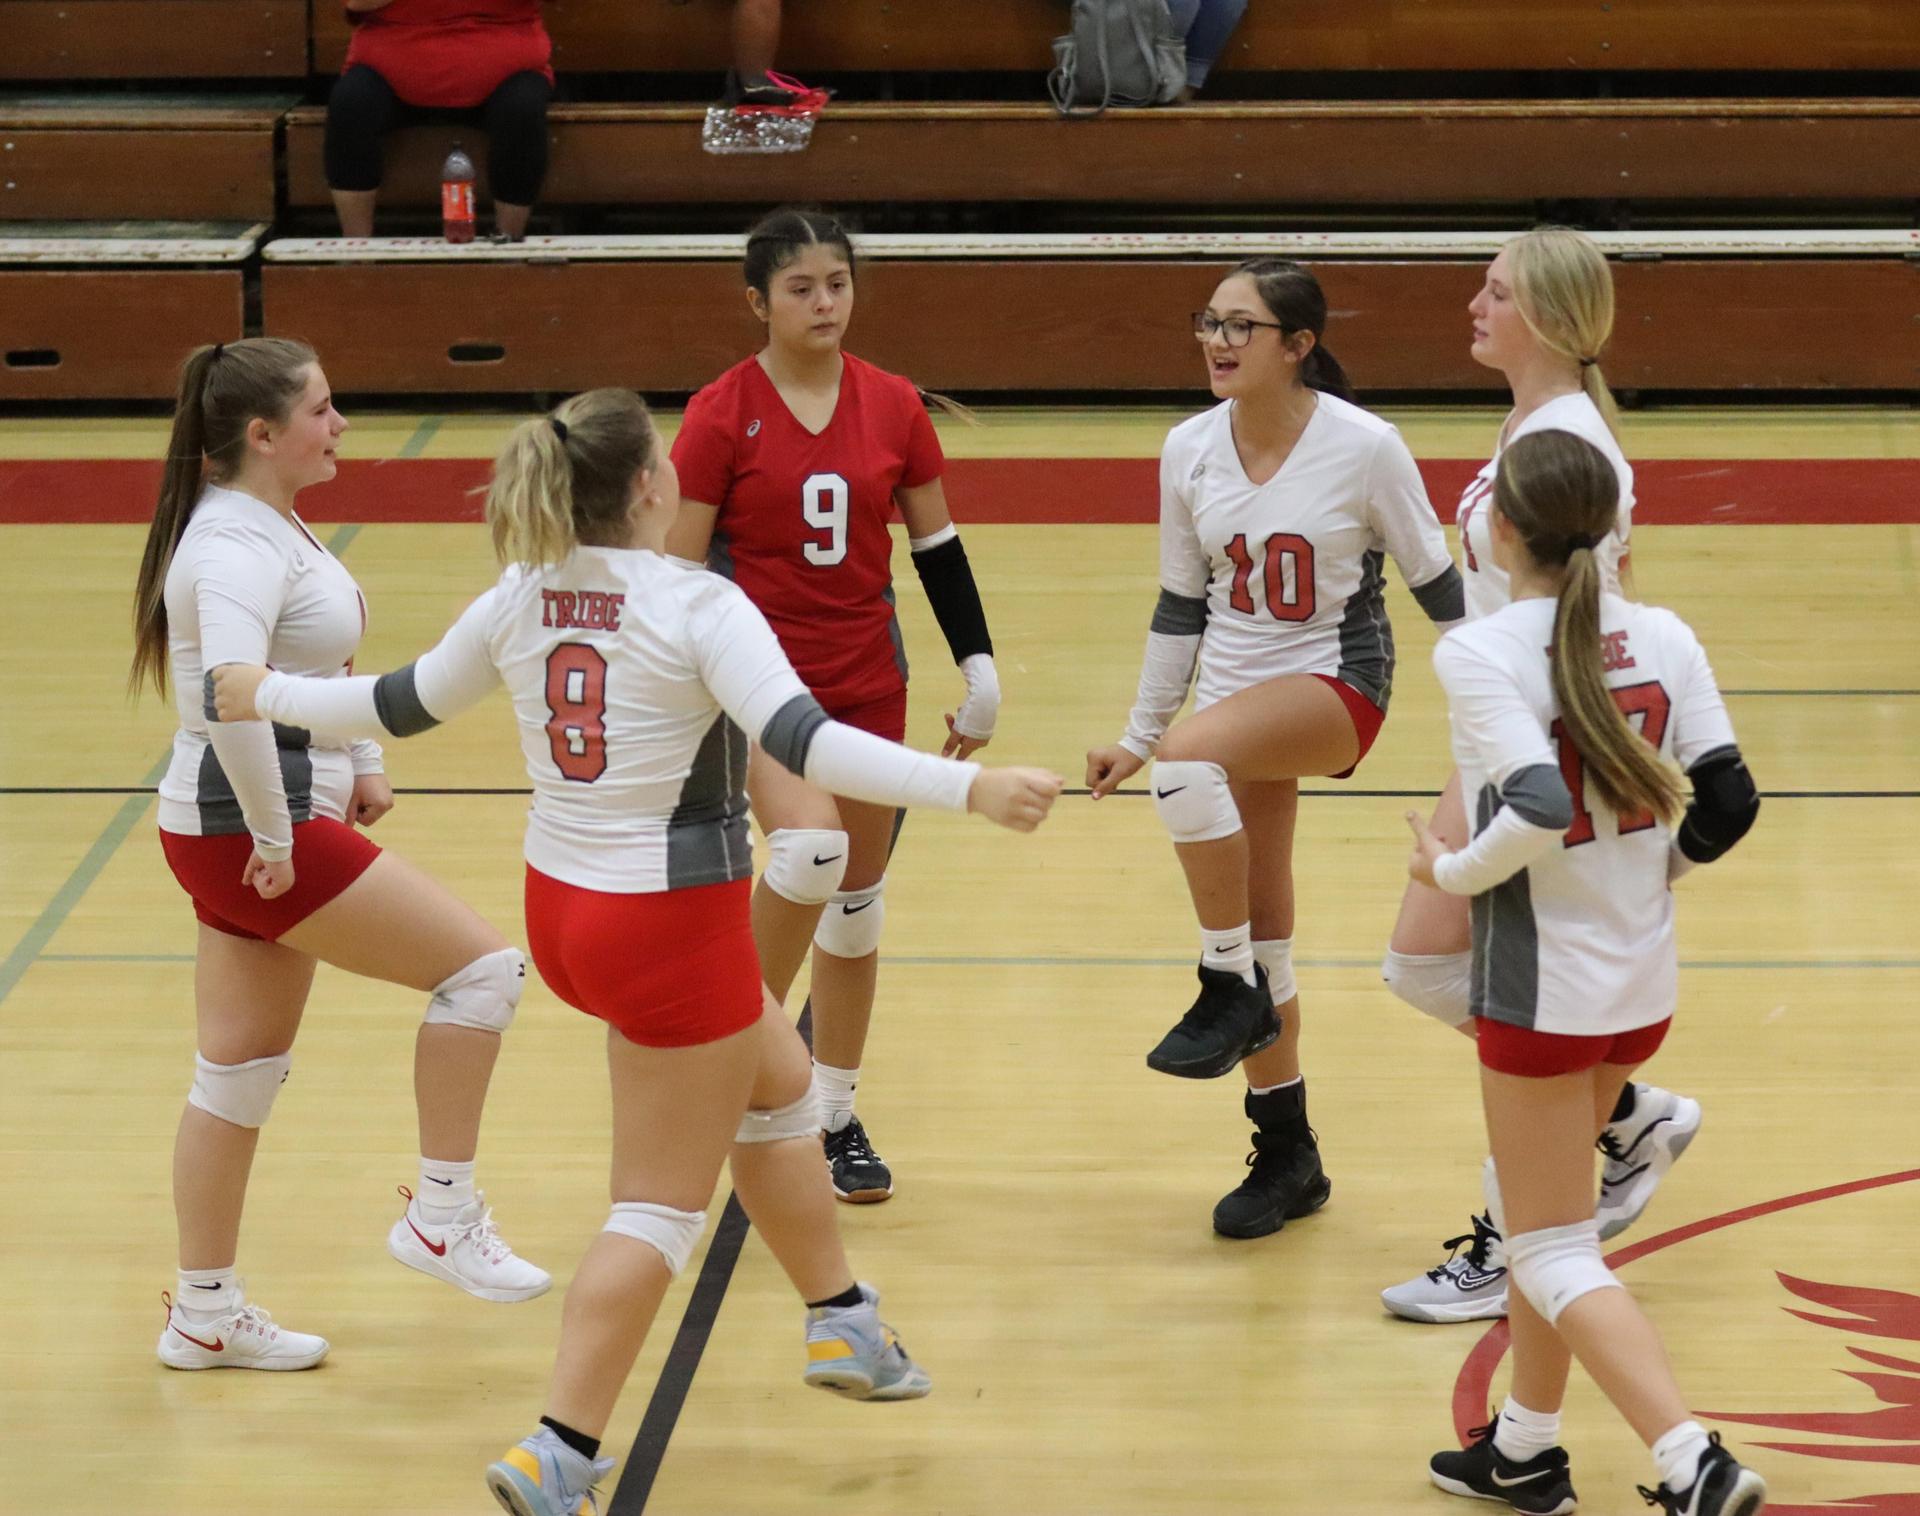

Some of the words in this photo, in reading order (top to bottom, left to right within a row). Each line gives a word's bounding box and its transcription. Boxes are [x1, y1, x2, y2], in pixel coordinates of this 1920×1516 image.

[802, 472, 850, 567] 9
[541, 587, 625, 632] TRIBE
[1223, 532, 1317, 623] 10
[544, 641, 608, 783] 8
